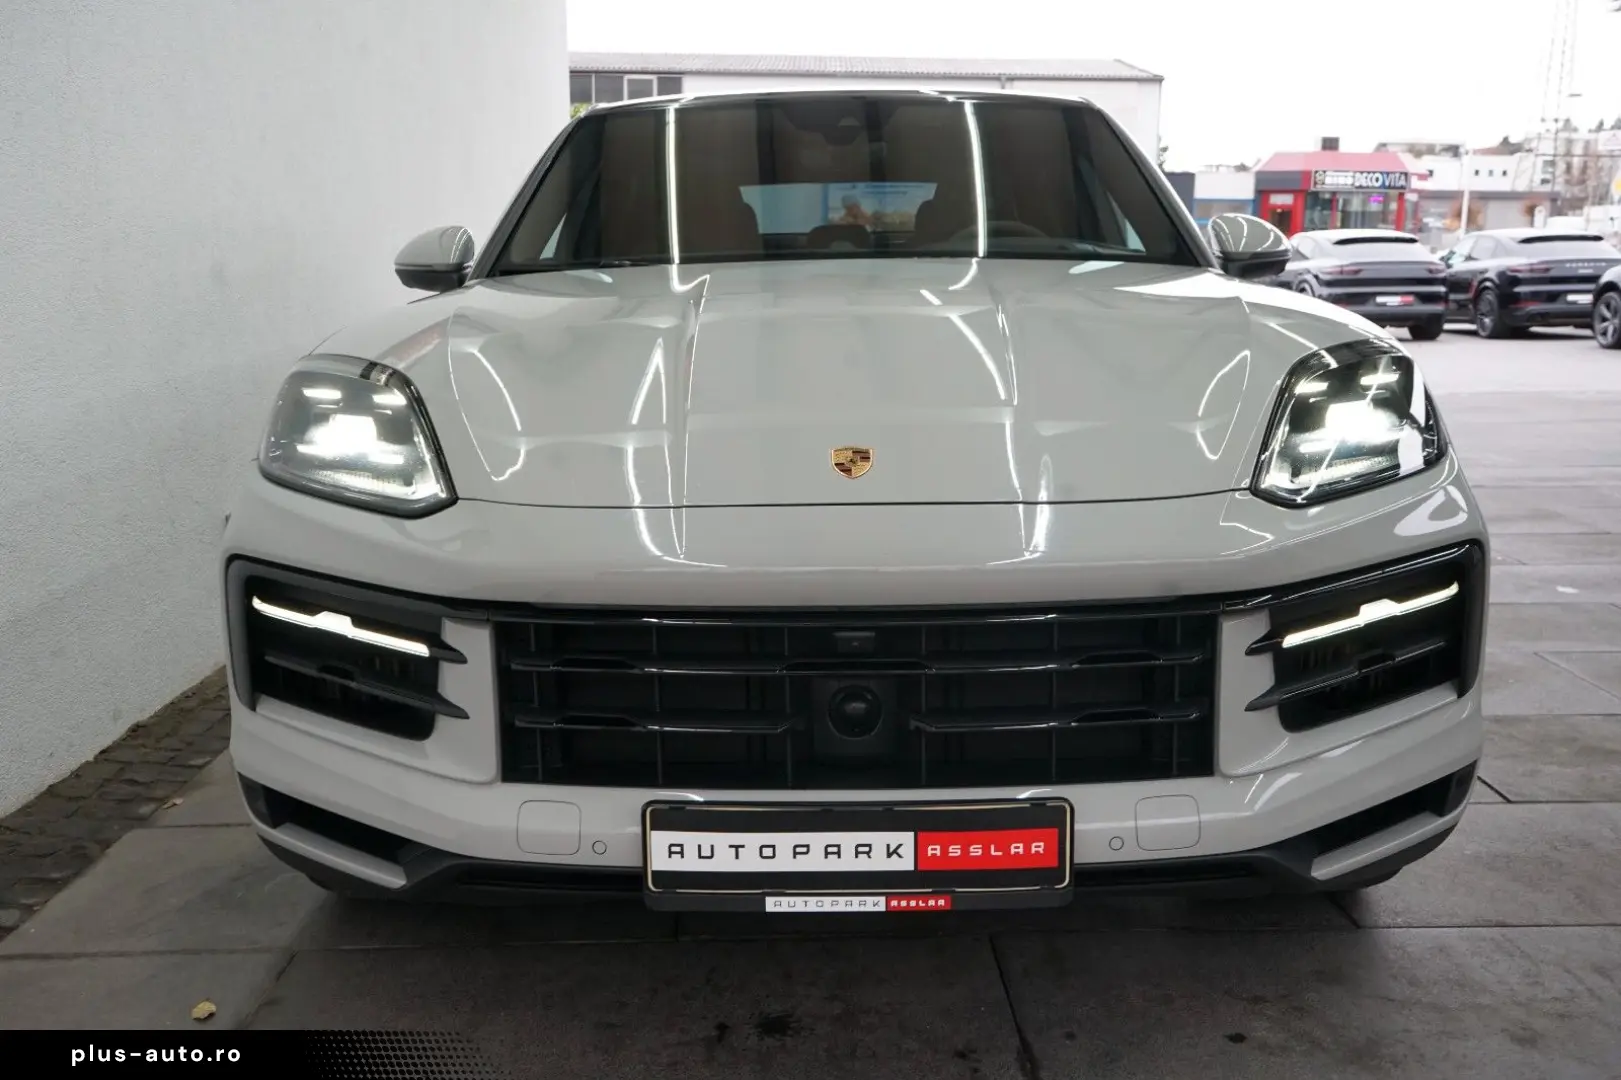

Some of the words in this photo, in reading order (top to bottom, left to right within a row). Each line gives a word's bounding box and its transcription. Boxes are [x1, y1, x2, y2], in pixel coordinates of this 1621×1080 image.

[667, 843, 904, 860] AUTOPARK
[927, 841, 1046, 858] ASSLAR
[773, 899, 881, 909] AUTOPARK
